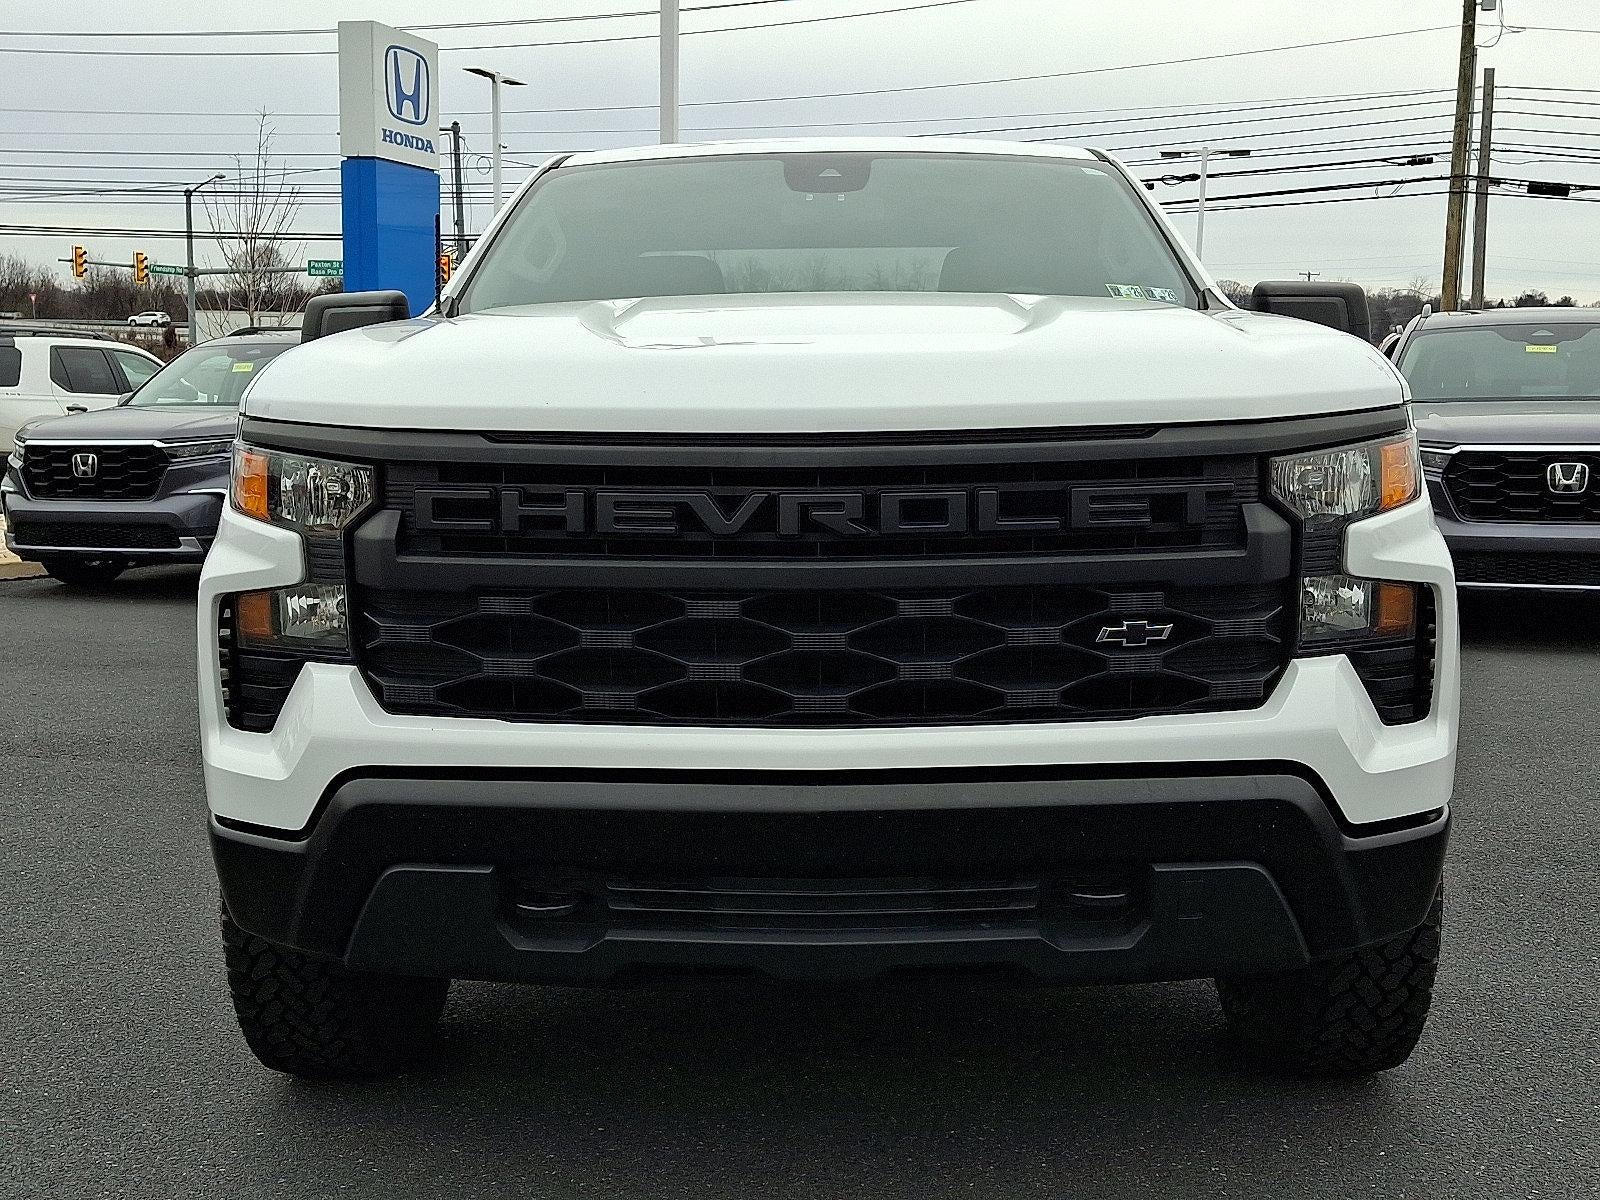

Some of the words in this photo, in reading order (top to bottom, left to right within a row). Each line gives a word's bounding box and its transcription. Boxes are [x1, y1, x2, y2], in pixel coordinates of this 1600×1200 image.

[381, 127, 436, 155] HONDA
[176, 266, 183, 275] Rd
[413, 480, 1236, 535] CHEVROLET
